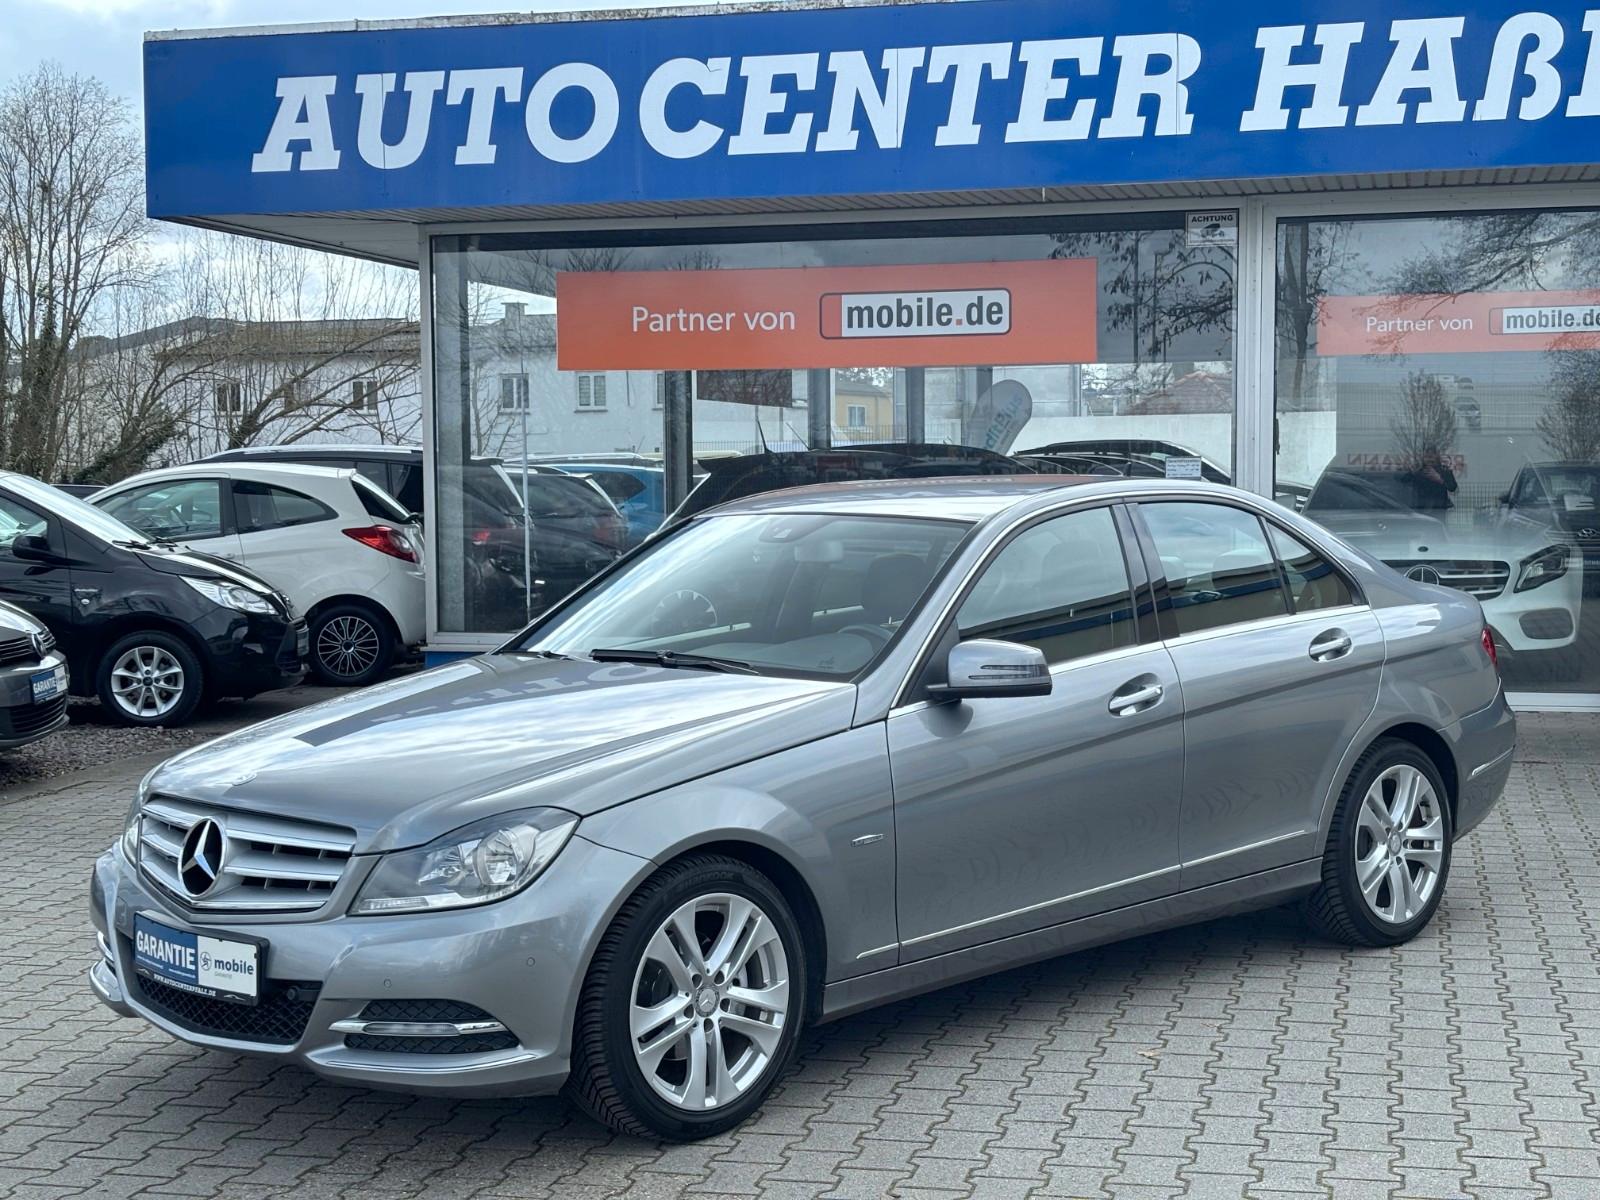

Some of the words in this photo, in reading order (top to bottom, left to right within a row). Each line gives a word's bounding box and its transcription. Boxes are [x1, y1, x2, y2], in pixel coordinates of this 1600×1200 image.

[1191, 214, 1234, 223] ACHTUNG
[632, 306, 736, 332] Partner
[743, 311, 796, 331] von
[846, 296, 1004, 328] mobile.de
[1366, 316, 1434, 332] Partner
[1439, 317, 1473, 331] von
[136, 930, 196, 970] GARANTIE
[214, 958, 255, 975] mobile
